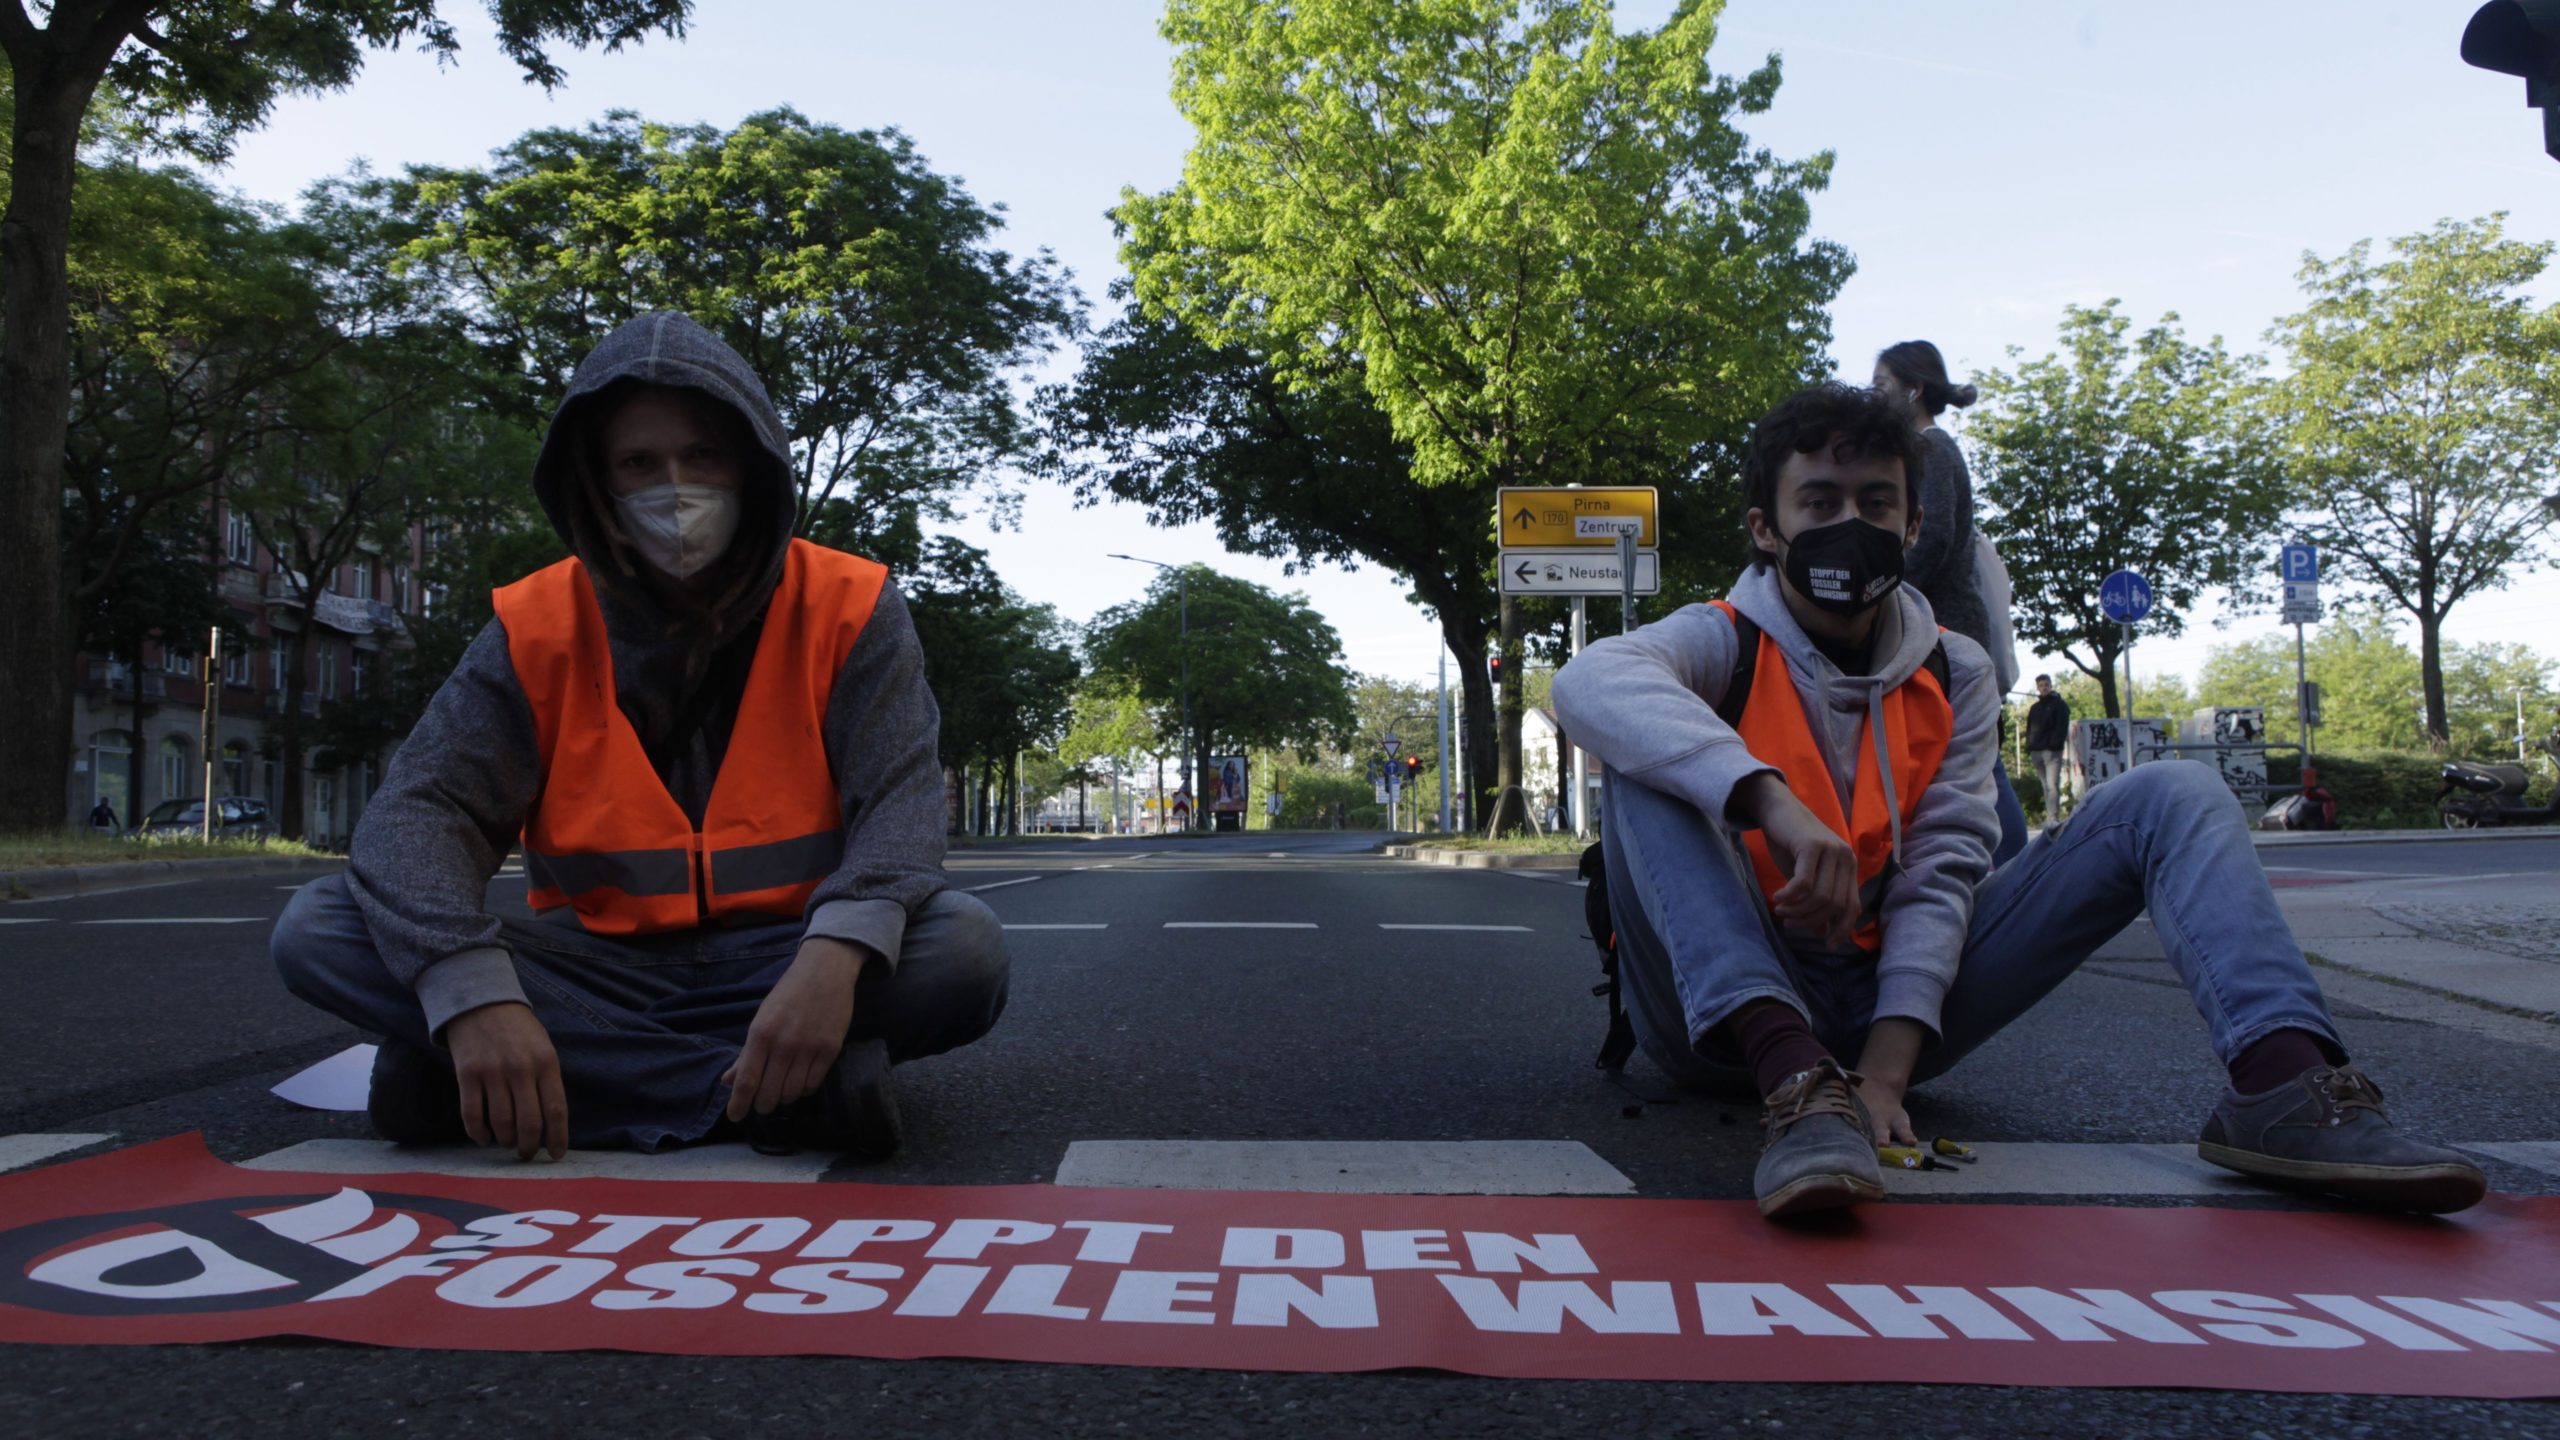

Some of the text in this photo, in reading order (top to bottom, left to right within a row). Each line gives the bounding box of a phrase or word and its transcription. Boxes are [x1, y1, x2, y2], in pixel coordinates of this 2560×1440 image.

[1573, 498, 1611, 511] Pirna
[1547, 513, 1564, 523] 170
[1579, 520, 1638, 534] Zentrum
[2290, 551, 2309, 577] P
[1569, 566, 1623, 579] Neusta
[1810, 568, 1834, 578] STOPPT
[430, 1209, 1600, 1274] STOPPT DEN
[304, 1250, 2560, 1353] FOSSILEN WAHNSIN
